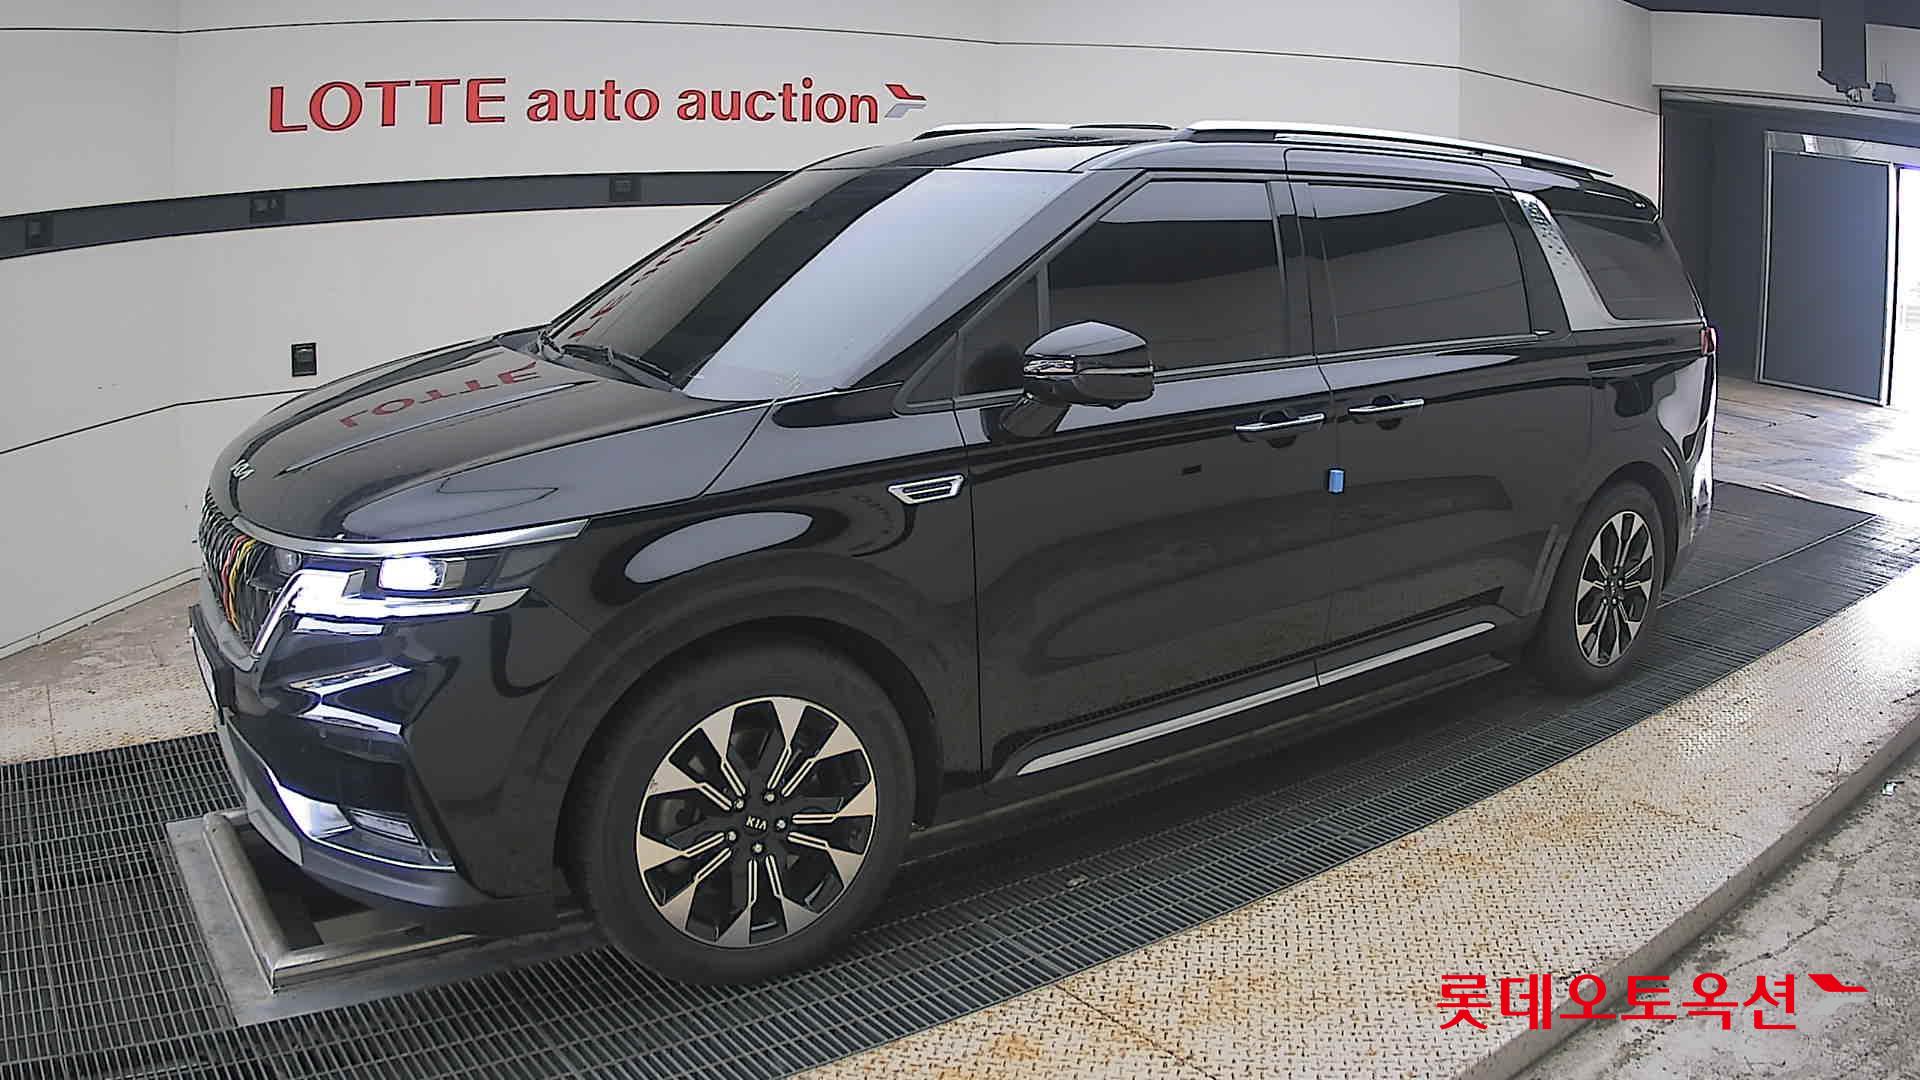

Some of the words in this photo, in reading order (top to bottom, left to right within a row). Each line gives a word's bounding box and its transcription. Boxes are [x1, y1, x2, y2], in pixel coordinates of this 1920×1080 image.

[269, 77, 507, 133] LOTTE
[526, 79, 661, 123] auto
[675, 76, 880, 125] auction
[746, 815, 767, 831] KIA
